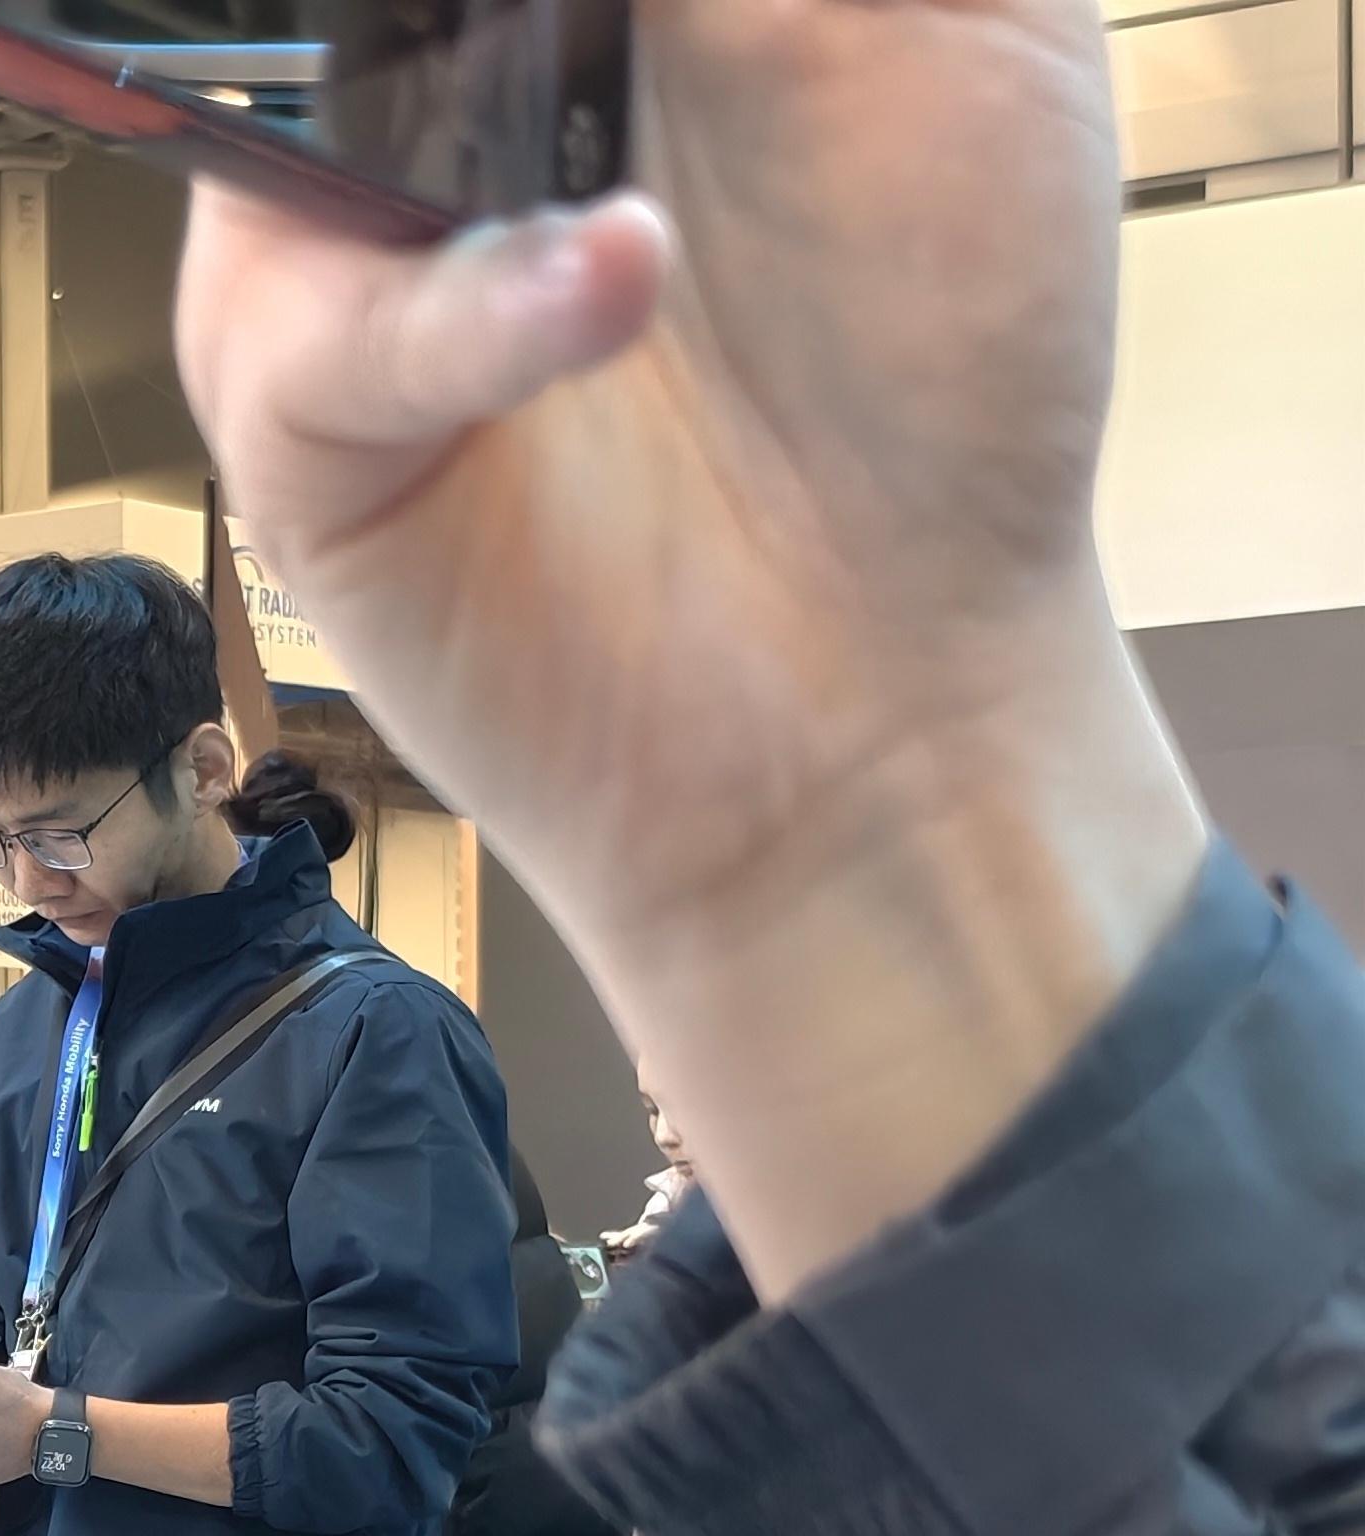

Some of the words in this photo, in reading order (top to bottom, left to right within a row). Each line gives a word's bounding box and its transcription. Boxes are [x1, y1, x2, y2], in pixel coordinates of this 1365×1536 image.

[65, 1018, 92, 1075] Mobility
[56, 1077, 72, 1121] Honda
[53, 1125, 66, 1158] Sony
